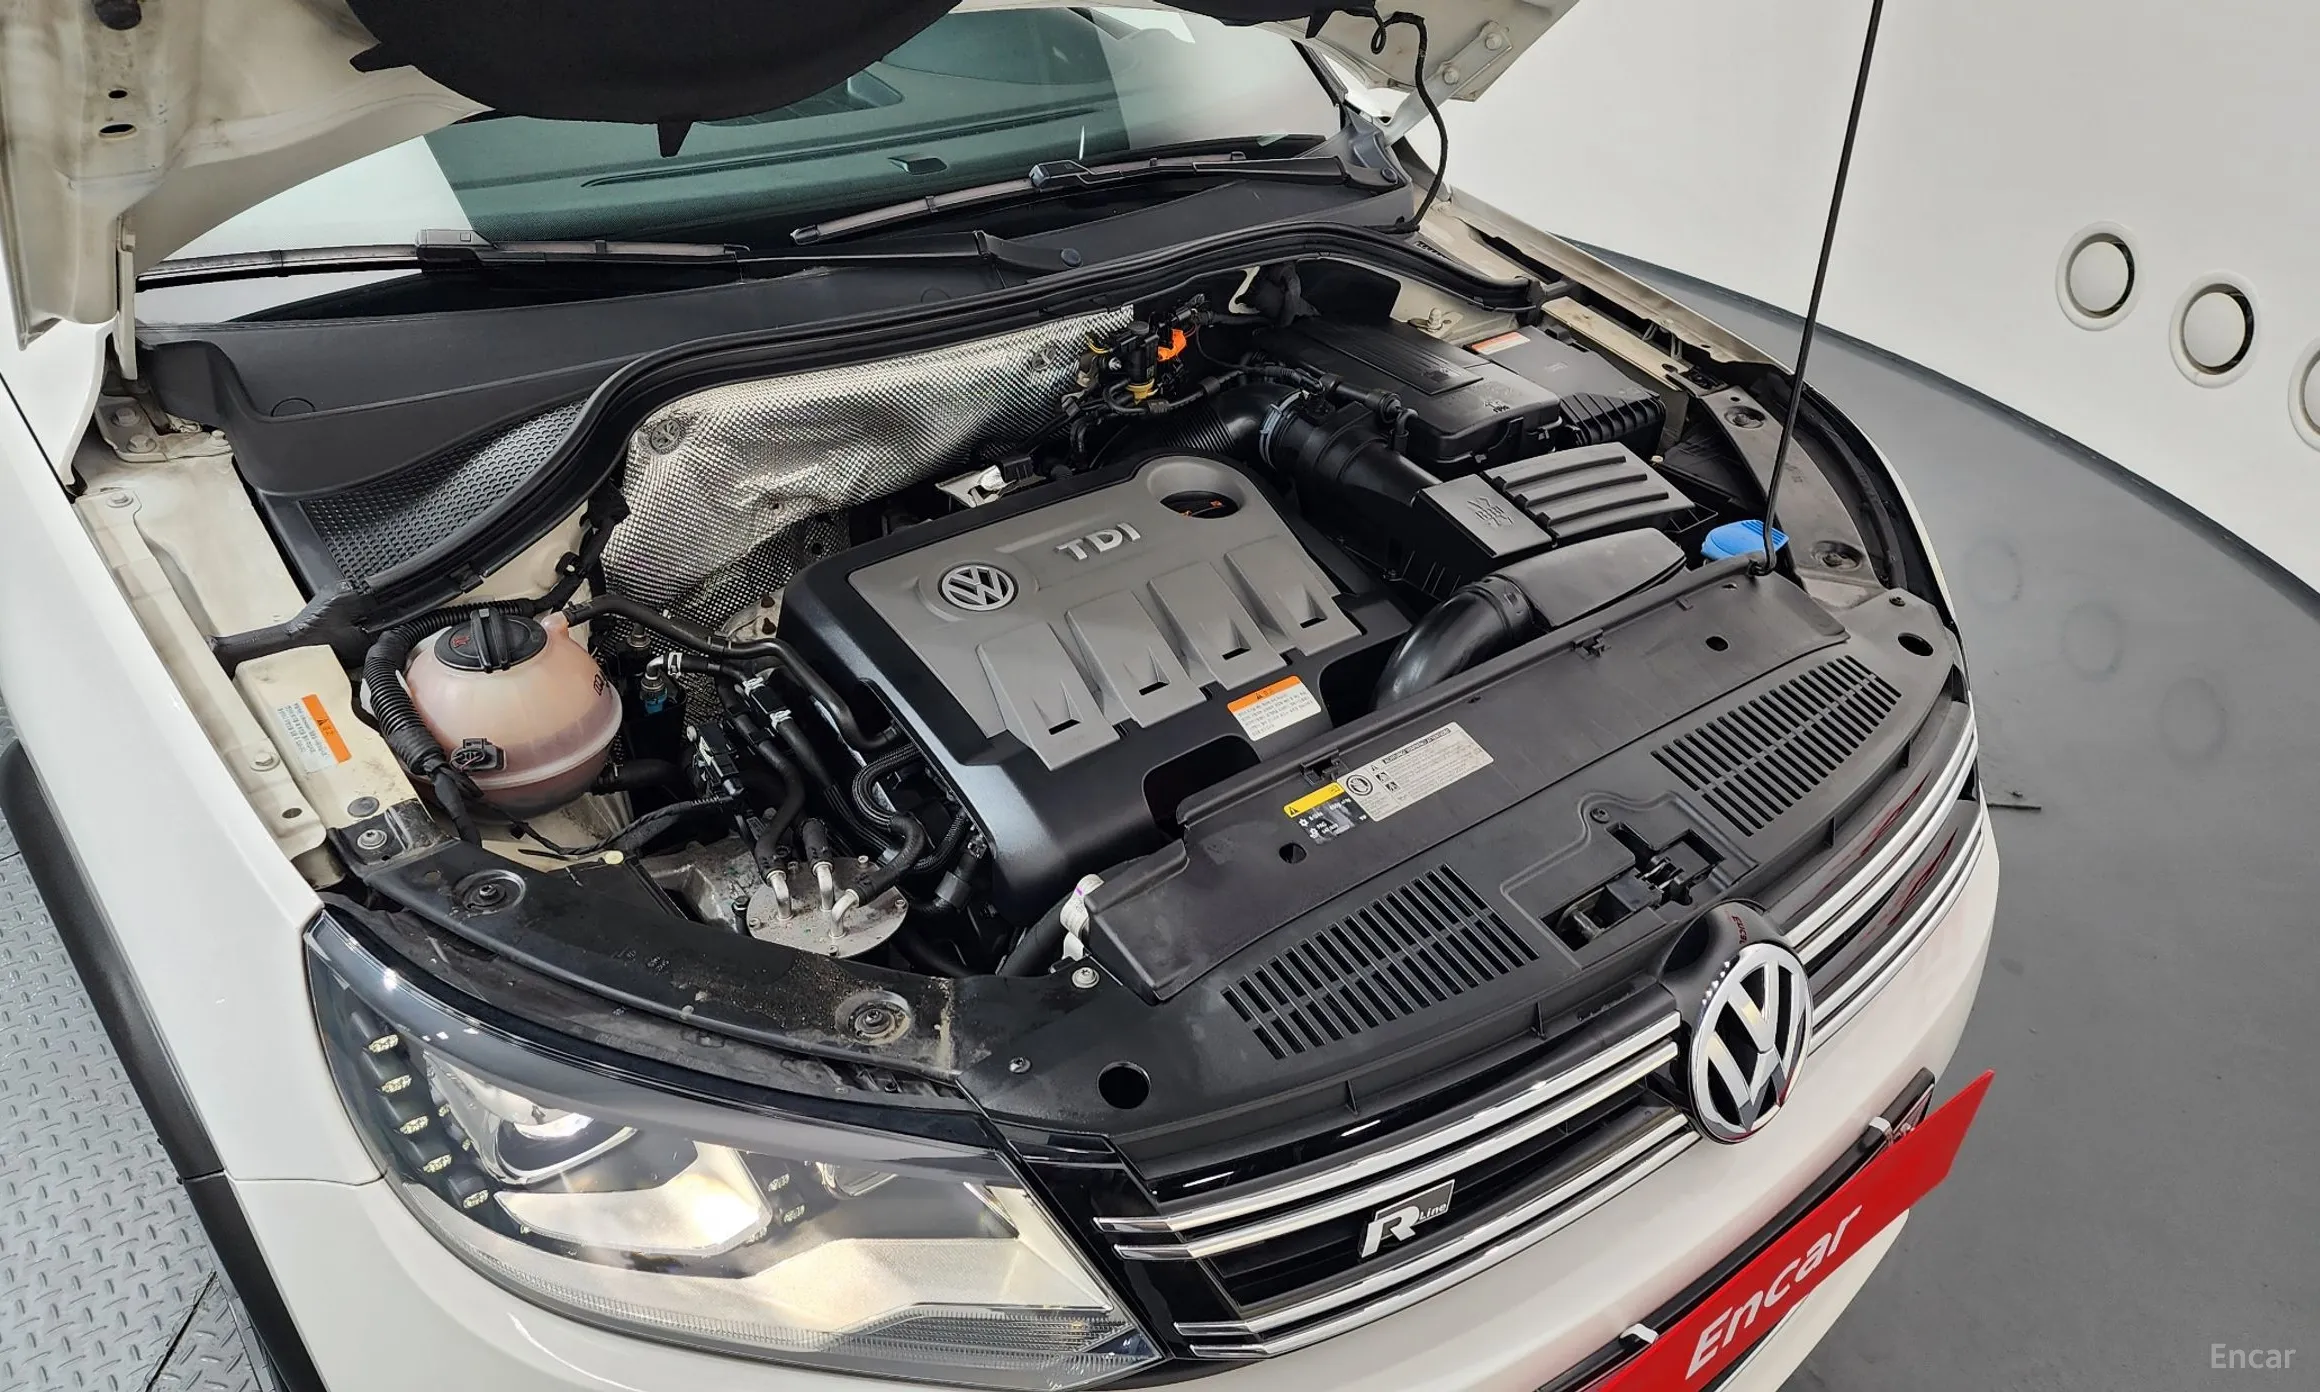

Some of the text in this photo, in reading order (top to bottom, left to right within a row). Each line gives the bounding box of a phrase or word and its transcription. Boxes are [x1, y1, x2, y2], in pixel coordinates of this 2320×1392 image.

[1054, 522, 1141, 561] TDI
[1362, 1202, 1447, 1258] R Line
[1685, 1204, 1863, 1381] Encar
